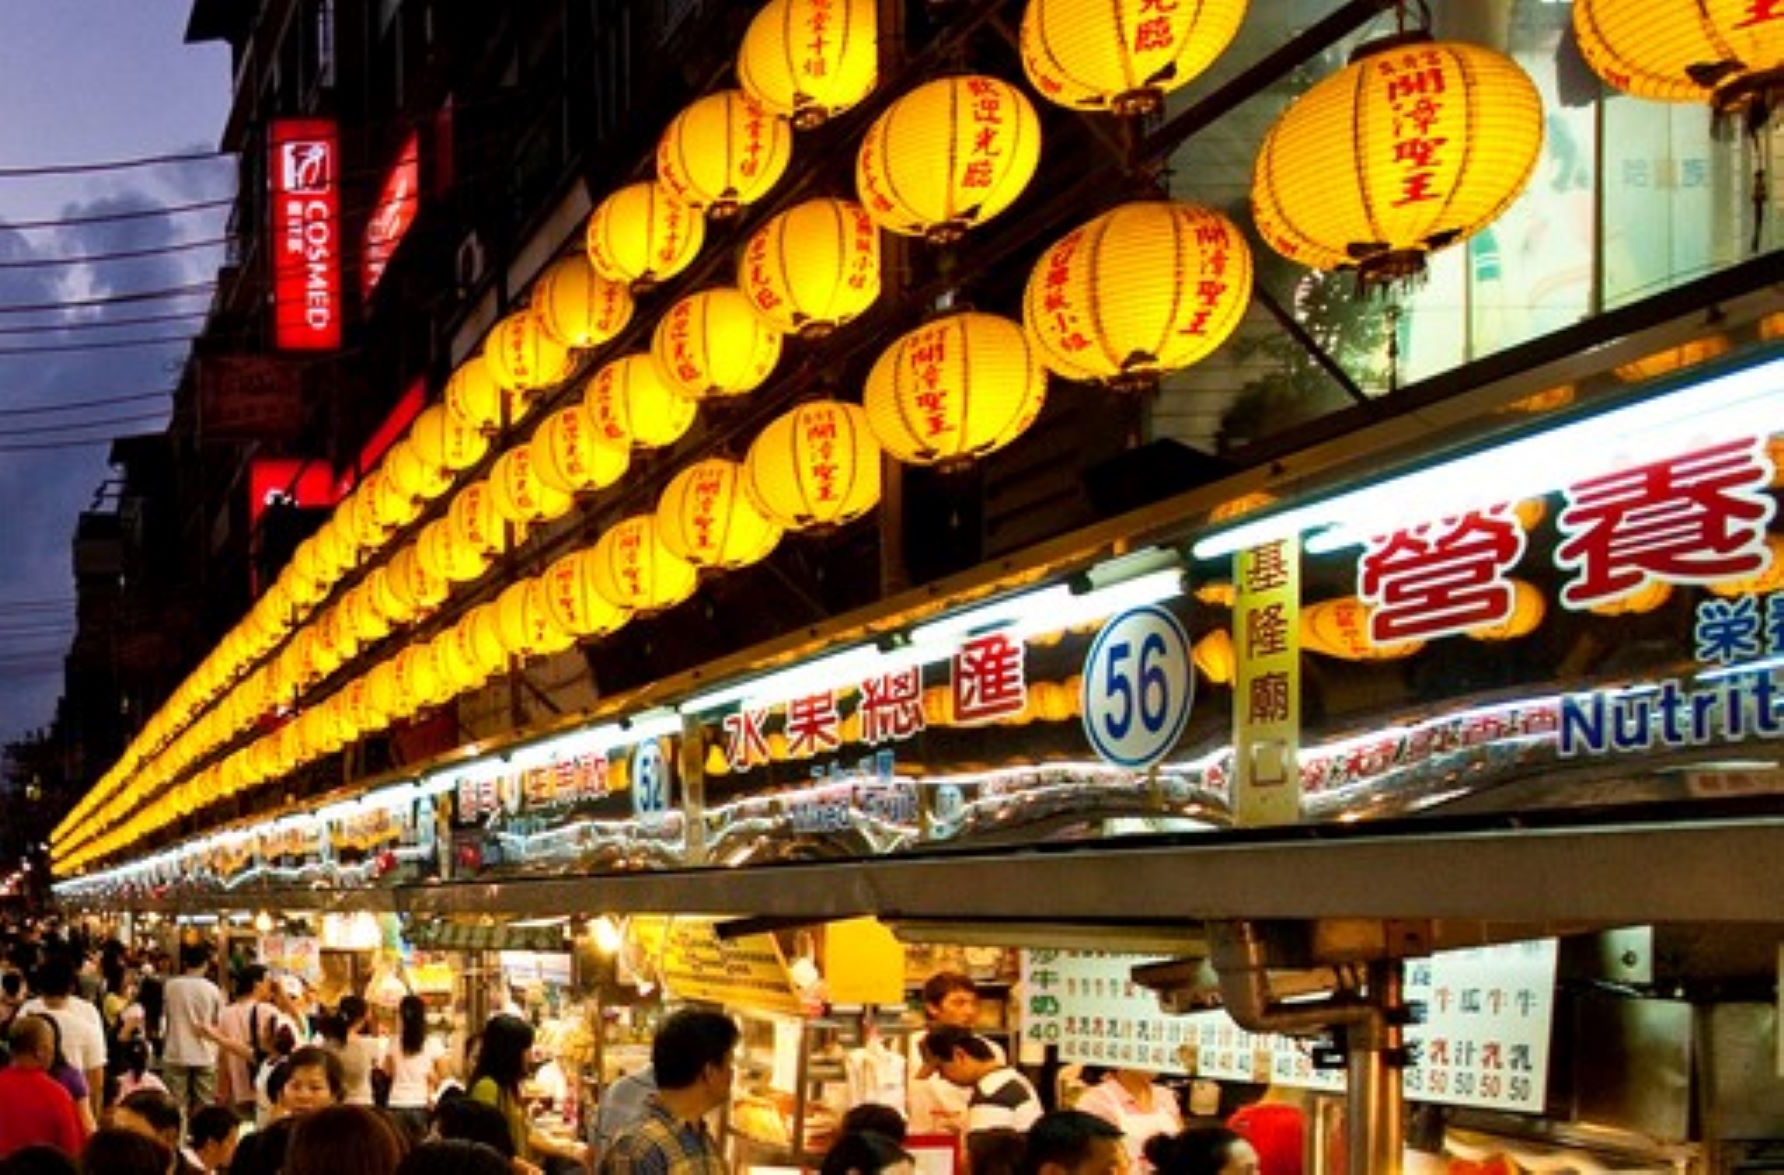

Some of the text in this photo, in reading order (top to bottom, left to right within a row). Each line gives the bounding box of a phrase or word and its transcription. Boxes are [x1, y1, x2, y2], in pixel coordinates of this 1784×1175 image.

[305, 200, 330, 330] COSMED
[1363, 436, 1764, 643] 營養
[1698, 594, 1784, 662] 栄
[724, 635, 1023, 769] 水果總匯
[1104, 632, 1170, 740] 56
[1480, 1073, 1502, 1099] 50
[1509, 1076, 1532, 1102] 50
